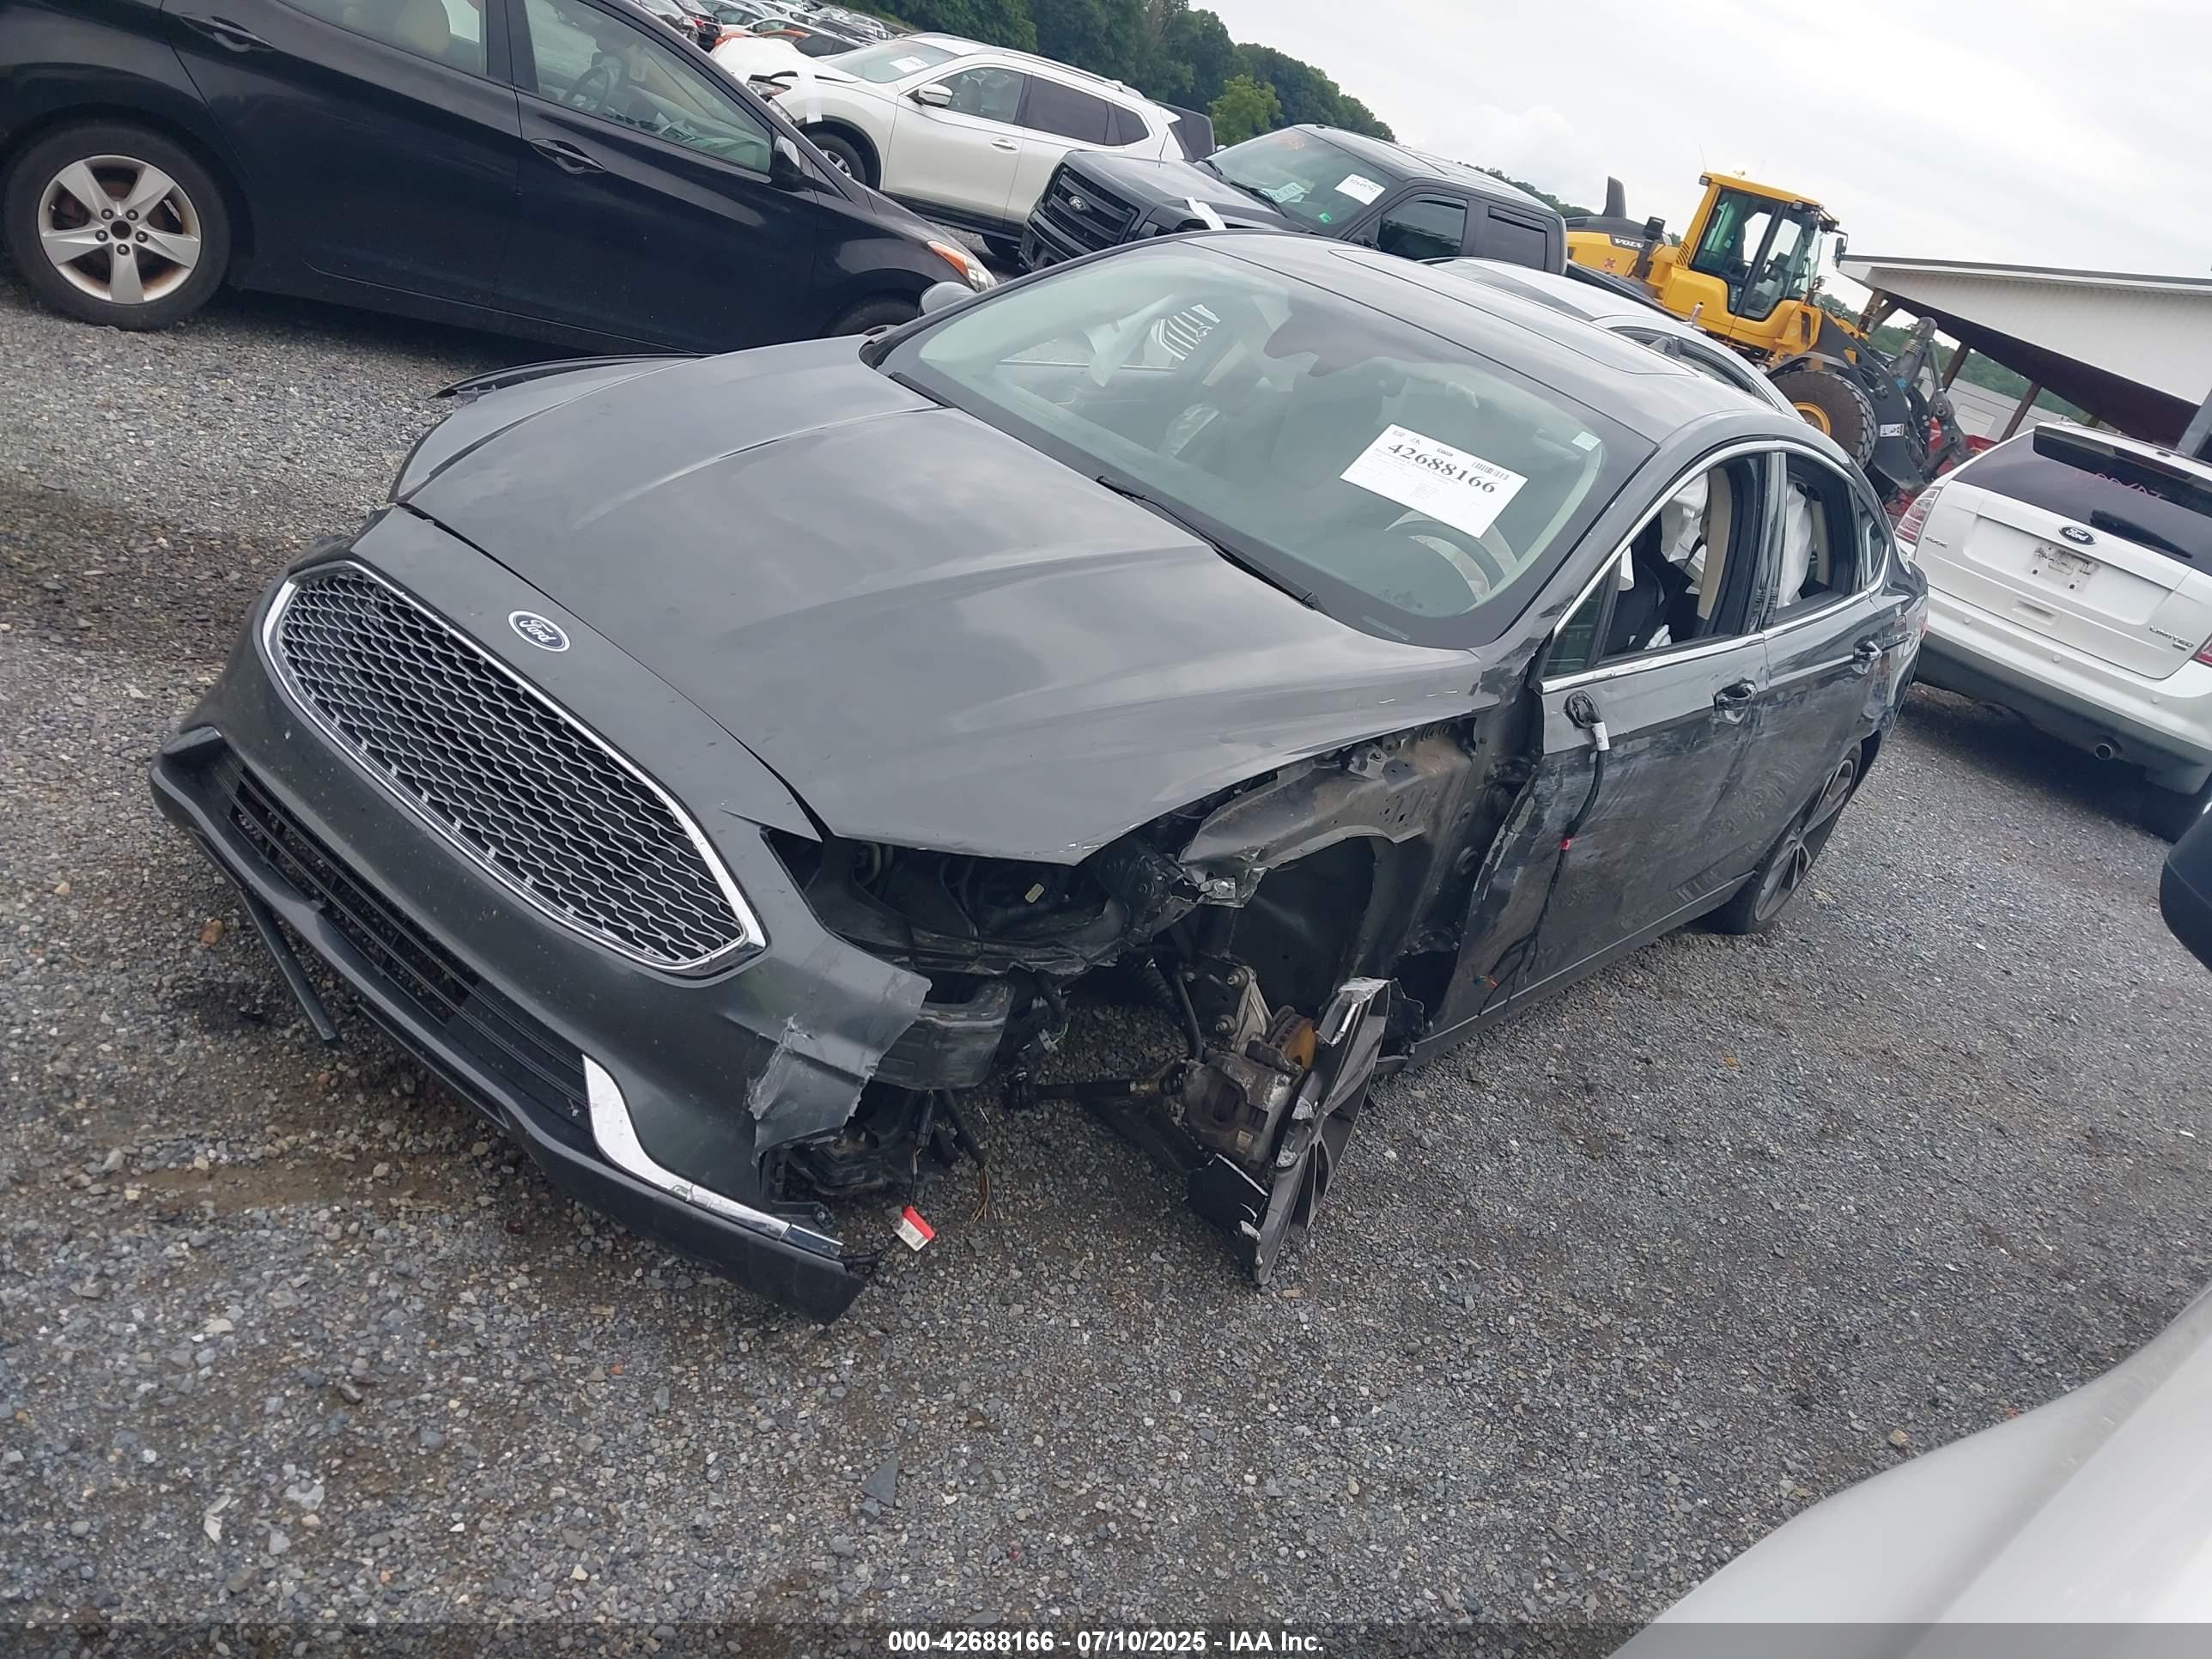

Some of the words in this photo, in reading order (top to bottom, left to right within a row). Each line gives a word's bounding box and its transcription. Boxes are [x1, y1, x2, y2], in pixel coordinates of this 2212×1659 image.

[1614, 239, 1644, 248] VOLV
[1388, 443, 1499, 494] 42688166
[2065, 527, 2089, 541] Ford
[519, 619, 557, 642] Ford
